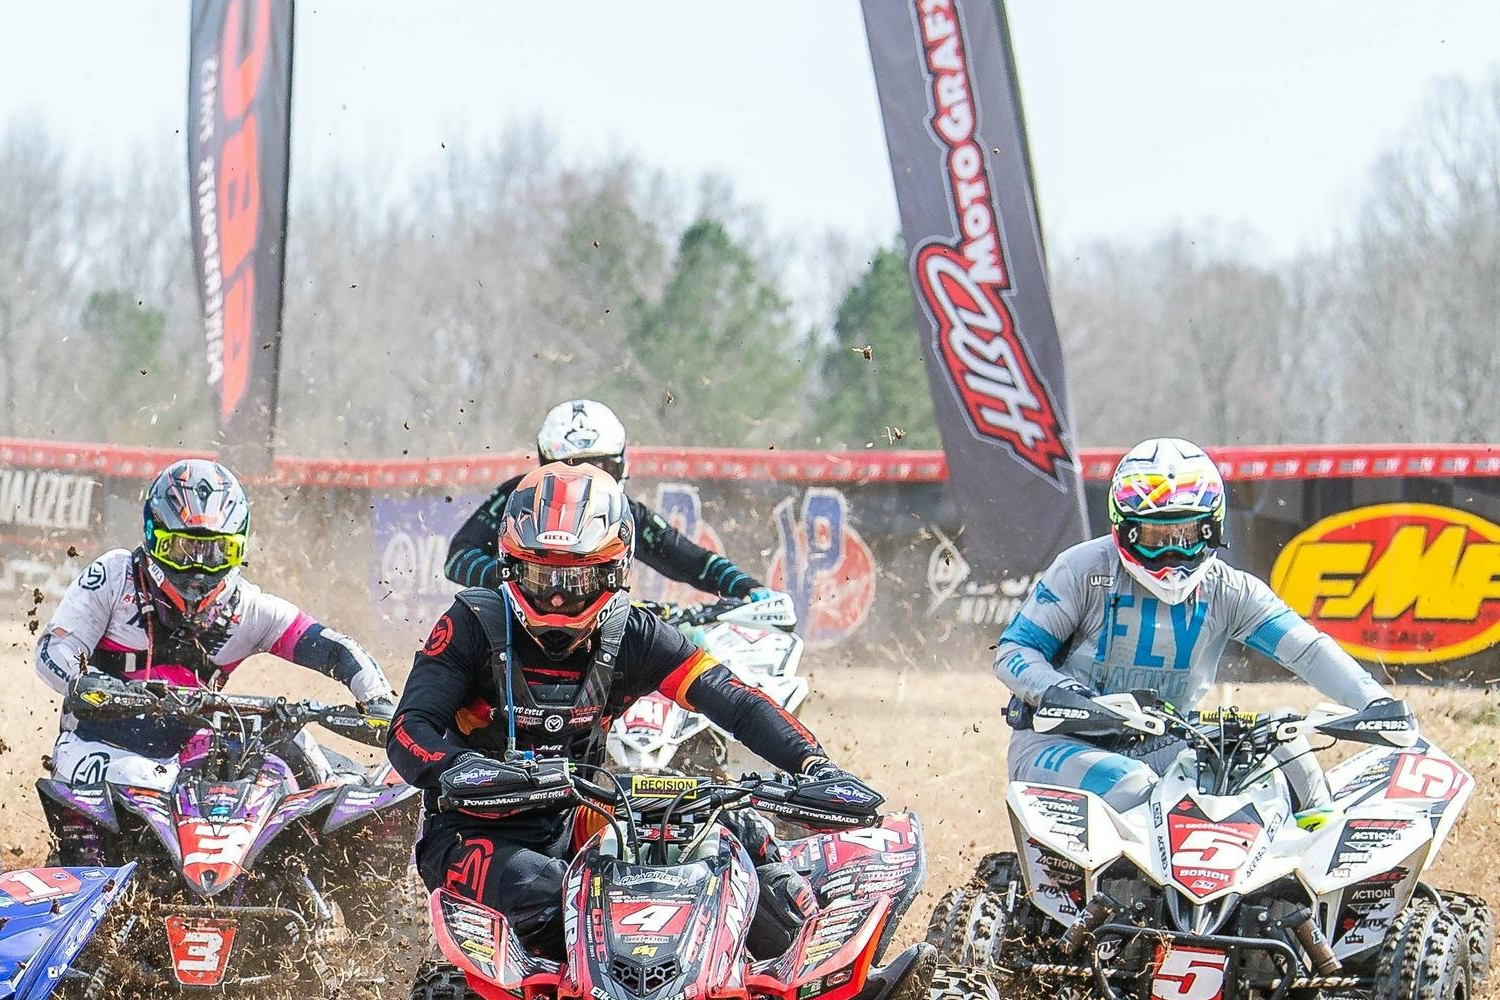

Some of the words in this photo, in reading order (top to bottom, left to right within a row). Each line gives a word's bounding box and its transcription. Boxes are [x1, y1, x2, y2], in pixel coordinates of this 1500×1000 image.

[543, 534, 572, 543] BELL
[1094, 592, 1209, 669] FLY
[1088, 662, 1190, 699] RACING
[1038, 706, 1091, 720] ACERBIS
[1354, 720, 1409, 731] ACERBIS
[1395, 756, 1456, 799] 5
[839, 828, 903, 853] 4
[1171, 830, 1249, 868] 5
[9, 870, 62, 898] 1
[1179, 869, 1230, 882] BORICH
[620, 904, 683, 932] 4
[177, 931, 224, 972] 3
